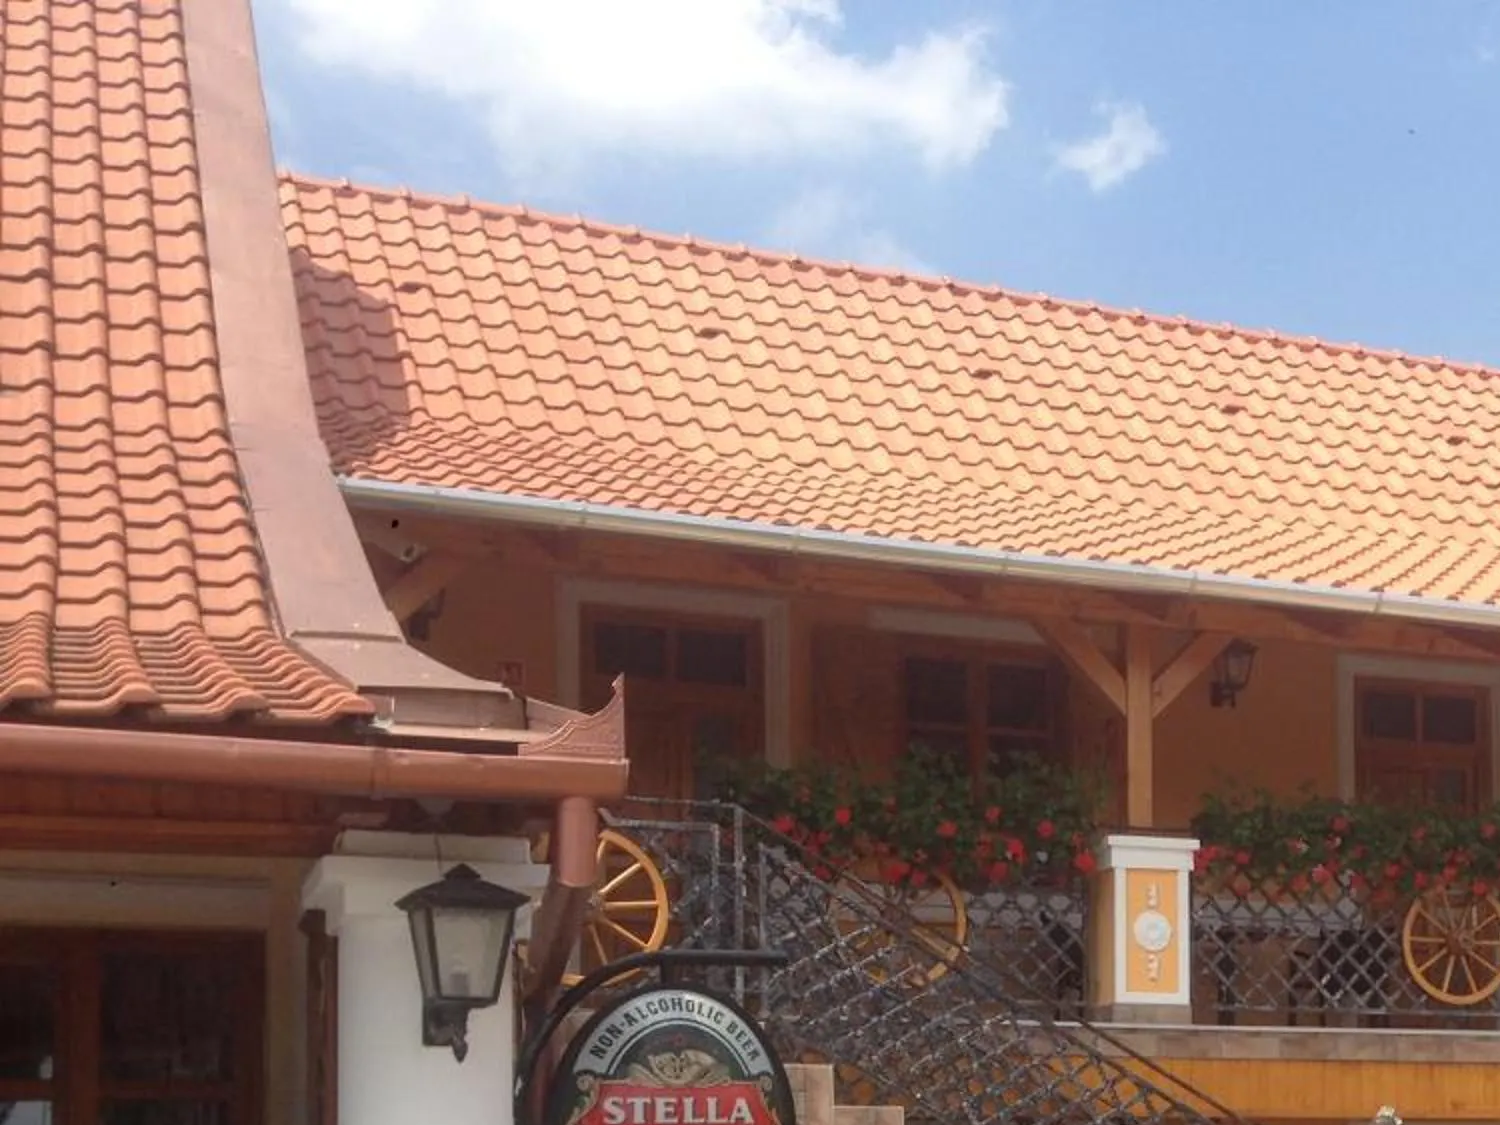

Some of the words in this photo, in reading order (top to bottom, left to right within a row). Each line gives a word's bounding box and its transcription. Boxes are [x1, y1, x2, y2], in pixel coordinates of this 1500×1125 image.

[590, 997, 722, 1060] NON-ALCOHOLIC
[726, 1017, 760, 1061] BEER
[602, 1096, 755, 1124] STELLA
